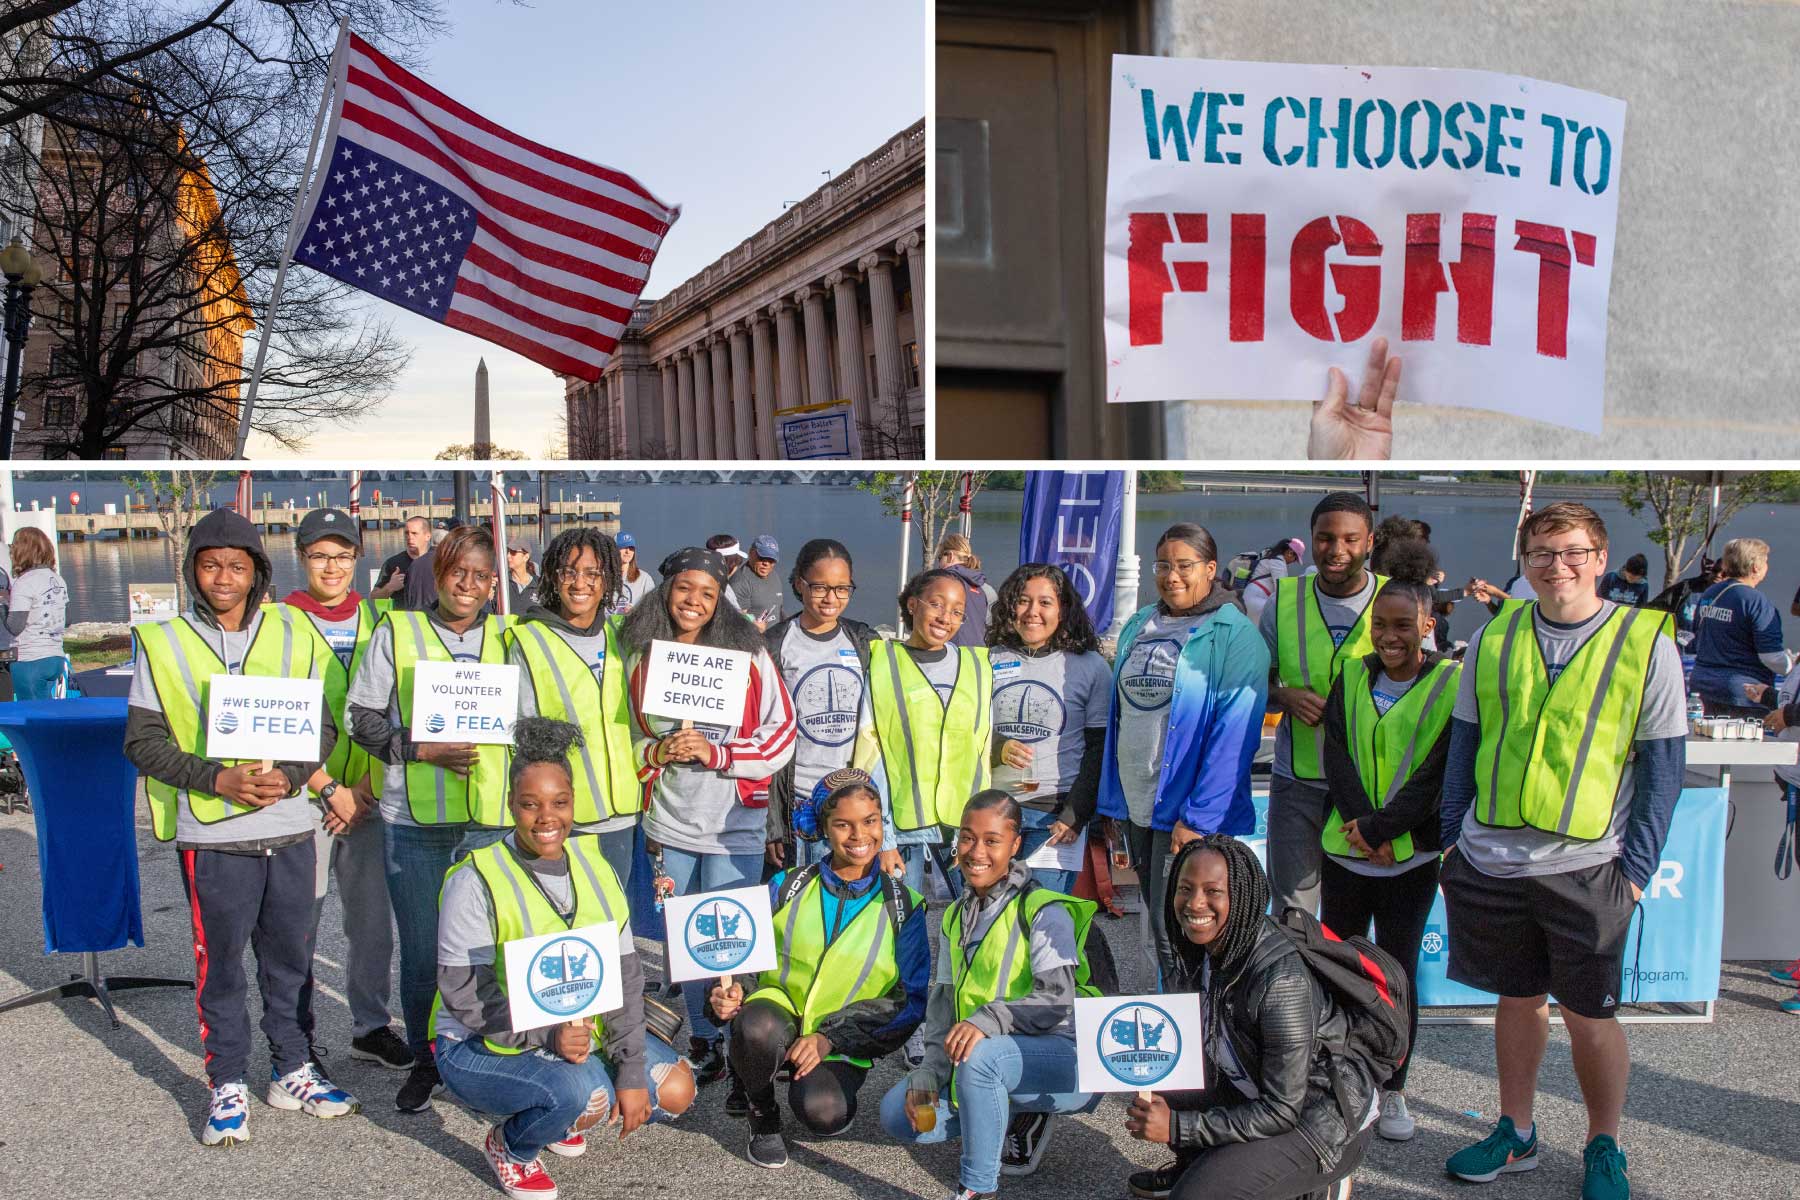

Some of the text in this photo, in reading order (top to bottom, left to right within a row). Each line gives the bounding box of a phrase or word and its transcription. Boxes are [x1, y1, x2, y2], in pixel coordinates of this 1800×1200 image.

[1141, 88, 1612, 196] WE CHOOSE TO
[1127, 212, 1598, 361] FIGHT
[667, 651, 734, 671] #WE ARE
[455, 671, 481, 680] #WE
[671, 672, 724, 690] PUBLIC
[432, 684, 502, 696] VOLUNTEER
[223, 697, 310, 711] #WE SUPPORT
[455, 701, 478, 710] FOR
[663, 691, 726, 710] SERVICE
[252, 716, 315, 735] FEEA
[456, 716, 505, 731] FEEA
[832, 713, 857, 724] SERVIC
[697, 941, 748, 953] PUBLIC SERVICE
[541, 981, 594, 999] PUBLIC SERVICE
[1111, 1053, 1169, 1063] PUBLIC SERVICE
